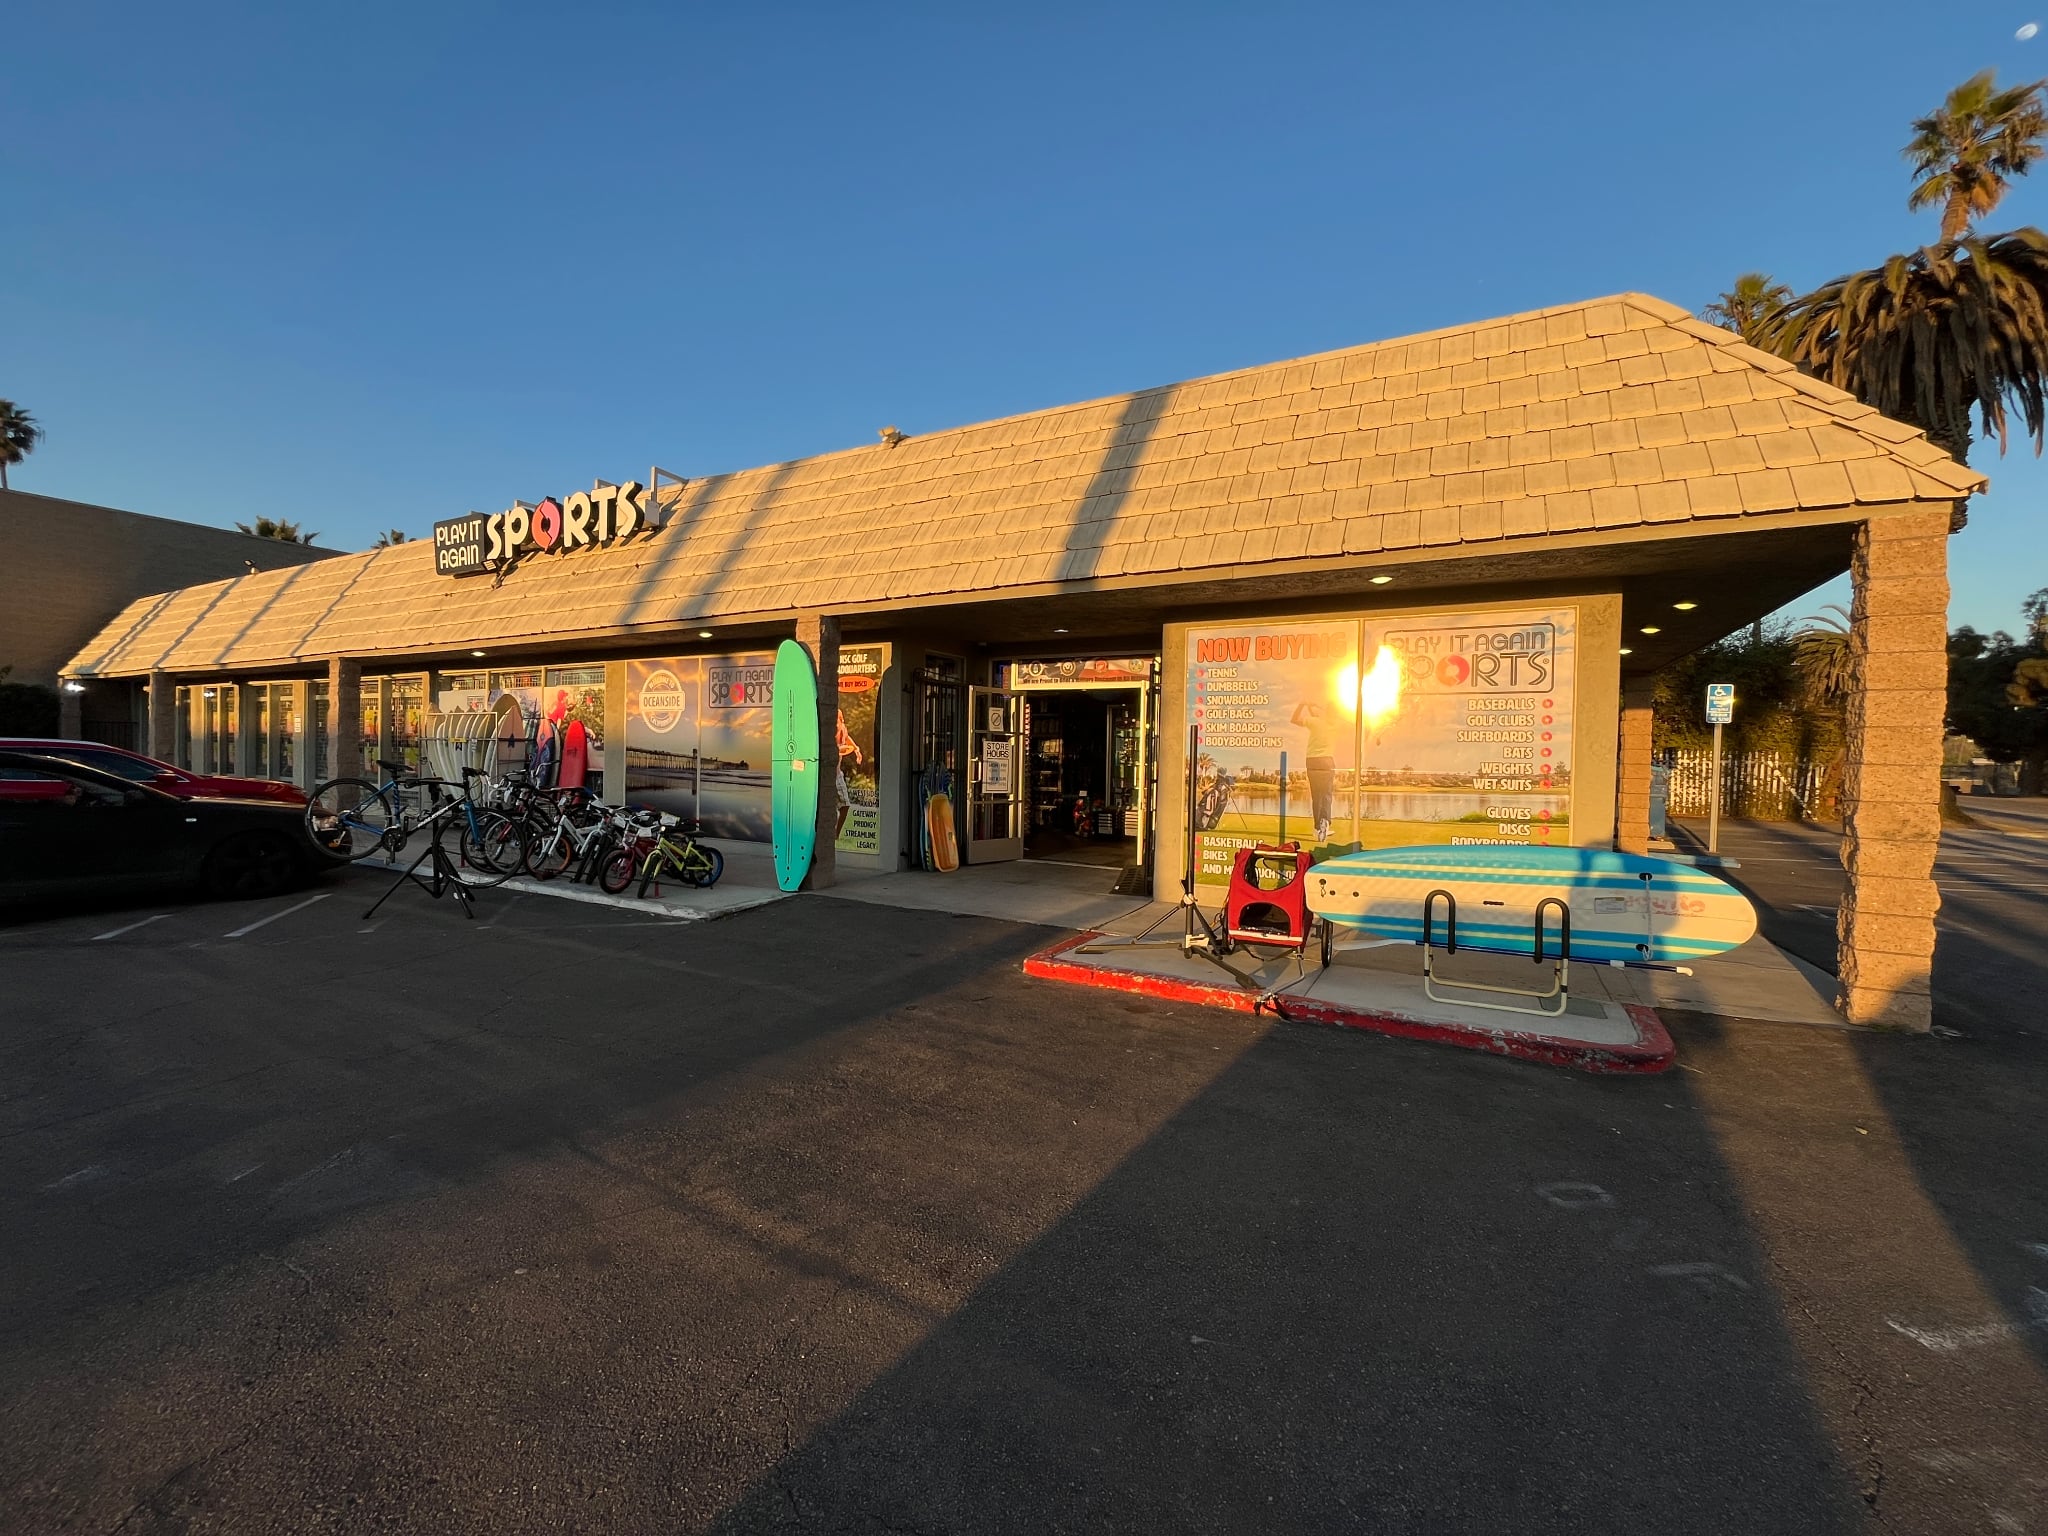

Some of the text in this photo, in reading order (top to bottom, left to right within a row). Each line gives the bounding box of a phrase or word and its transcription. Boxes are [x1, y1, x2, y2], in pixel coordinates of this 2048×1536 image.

[486, 481, 641, 560] SPORTS
[436, 520, 481, 547] PLAY IT
[439, 545, 479, 569] AGAIN
[1197, 632, 1347, 663] NOW BUYING
[1450, 634, 1469, 652] IT
[1475, 631, 1545, 650] AGAIN
[852, 653, 868, 663] GOLF
[712, 669, 773, 682] PLAY IT AGAIN
[837, 664, 877, 674] ADQUARTERS
[1207, 668, 1238, 678] TENNIS
[1406, 651, 1547, 687] PORTS
[712, 681, 774, 704] SPORTS
[1206, 681, 1258, 692] DUMBBELLS
[643, 695, 680, 707] OCEANSIDE
[1206, 695, 1269, 705] SNOWBOARDS
[1468, 698, 1535, 711] BASEBALLS
[1206, 709, 1254, 719] GOLF BAGS
[1466, 714, 1535, 727] GOLF CLUBS
[1206, 722, 1266, 733] SKIM BOARDS
[1205, 736, 1283, 747] BODYBOARD FINS
[1457, 730, 1534, 743] SURFBOARDS
[986, 742, 1009, 750] STORE
[1503, 746, 1533, 759] BATS
[986, 750, 1009, 758] HOURS
[1481, 762, 1532, 775] WEIGHTS
[1473, 779, 1532, 791] WET SUITS
[1486, 807, 1531, 820] GLOVES
[1499, 823, 1531, 836] DISCS
[1203, 850, 1228, 861] BIKES
[1203, 864, 1221, 875] AND
